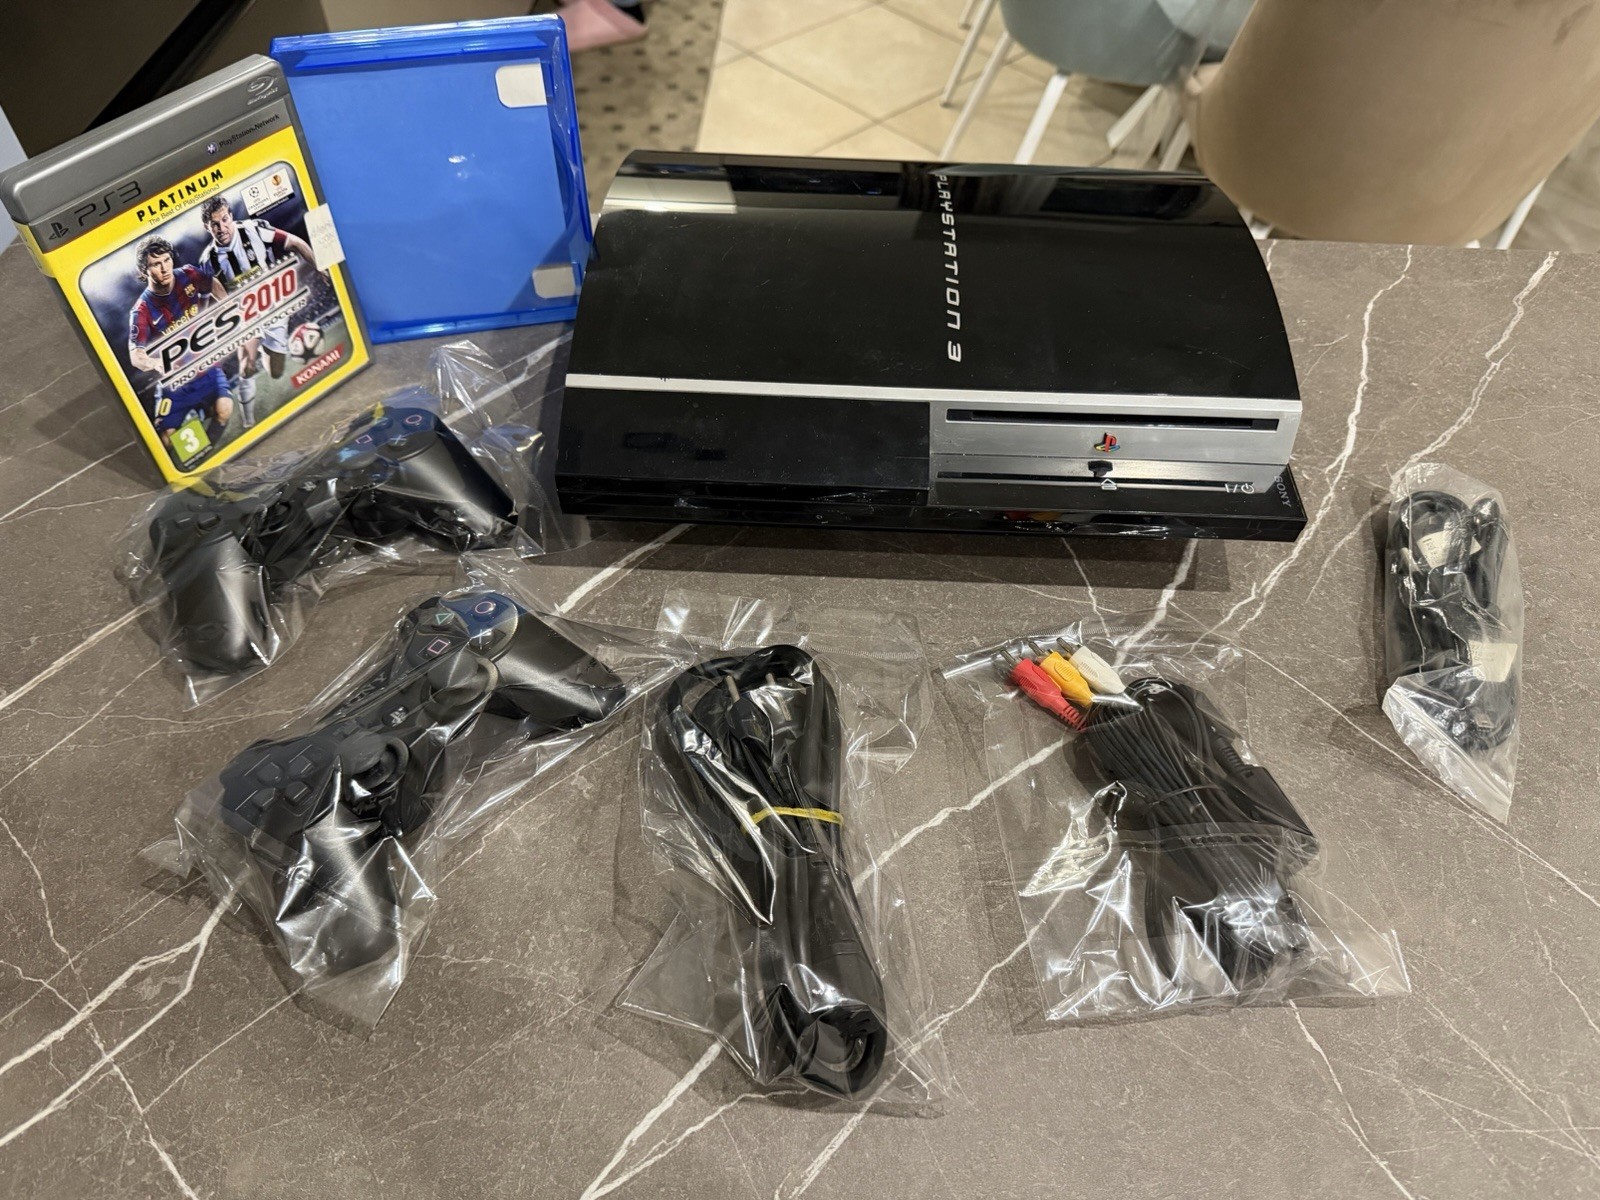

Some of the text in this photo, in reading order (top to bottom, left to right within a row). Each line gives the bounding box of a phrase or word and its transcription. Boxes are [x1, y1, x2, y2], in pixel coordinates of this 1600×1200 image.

[74, 180, 142, 227] PS3
[136, 169, 223, 222] PLATINUM
[149, 216, 160, 226] The
[160, 207, 175, 220] Best
[935, 174, 962, 362] PLAYSTATION 3
[161, 269, 296, 374] PES 2010
[161, 309, 190, 336] unicef
[171, 298, 306, 390] PRO EVOLUTION SOCCER
[296, 349, 341, 385] KONAMI
[180, 427, 200, 453] 3
[1273, 475, 1292, 508] SONY
